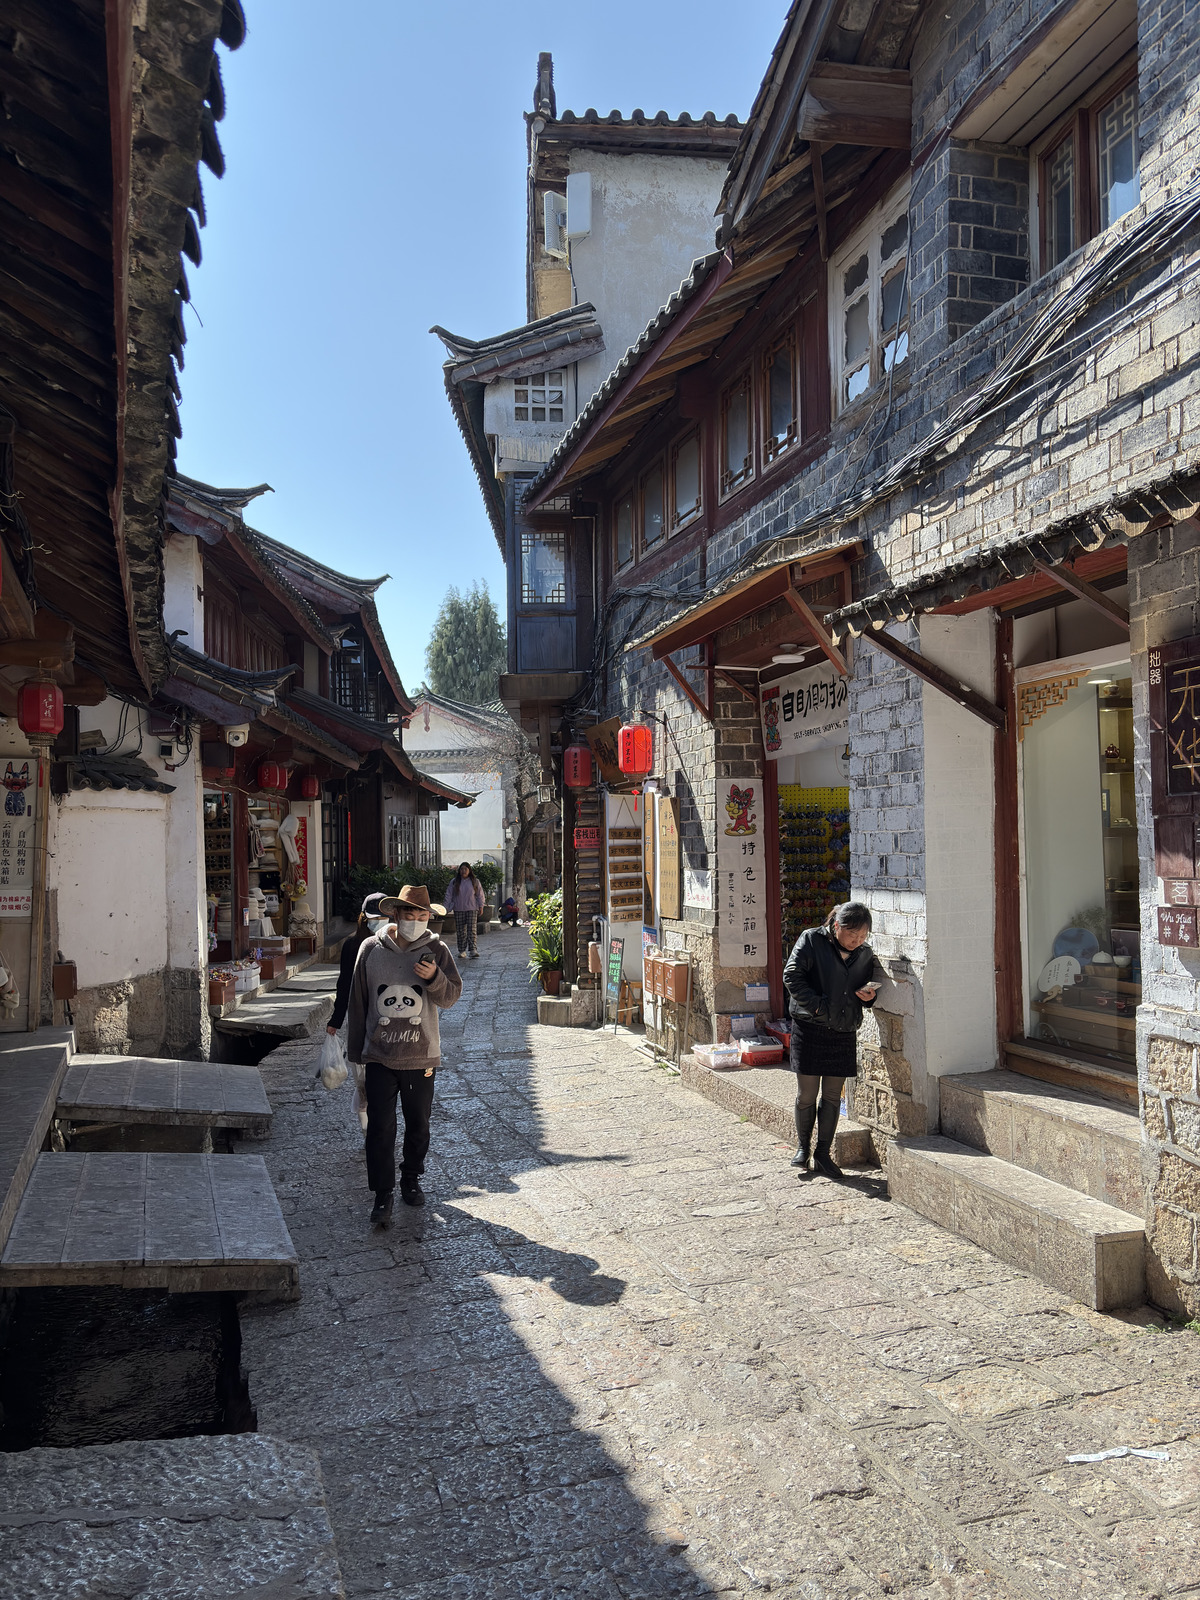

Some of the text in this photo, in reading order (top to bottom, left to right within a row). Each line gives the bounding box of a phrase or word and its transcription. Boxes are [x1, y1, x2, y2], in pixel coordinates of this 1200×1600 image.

[1149, 650, 1161, 685] 拙器
[793, 727, 821, 739] SELF-SERVICE
[822, 721, 842, 733] SHOPPING
[1160, 911, 1192, 924] Wu Hua
